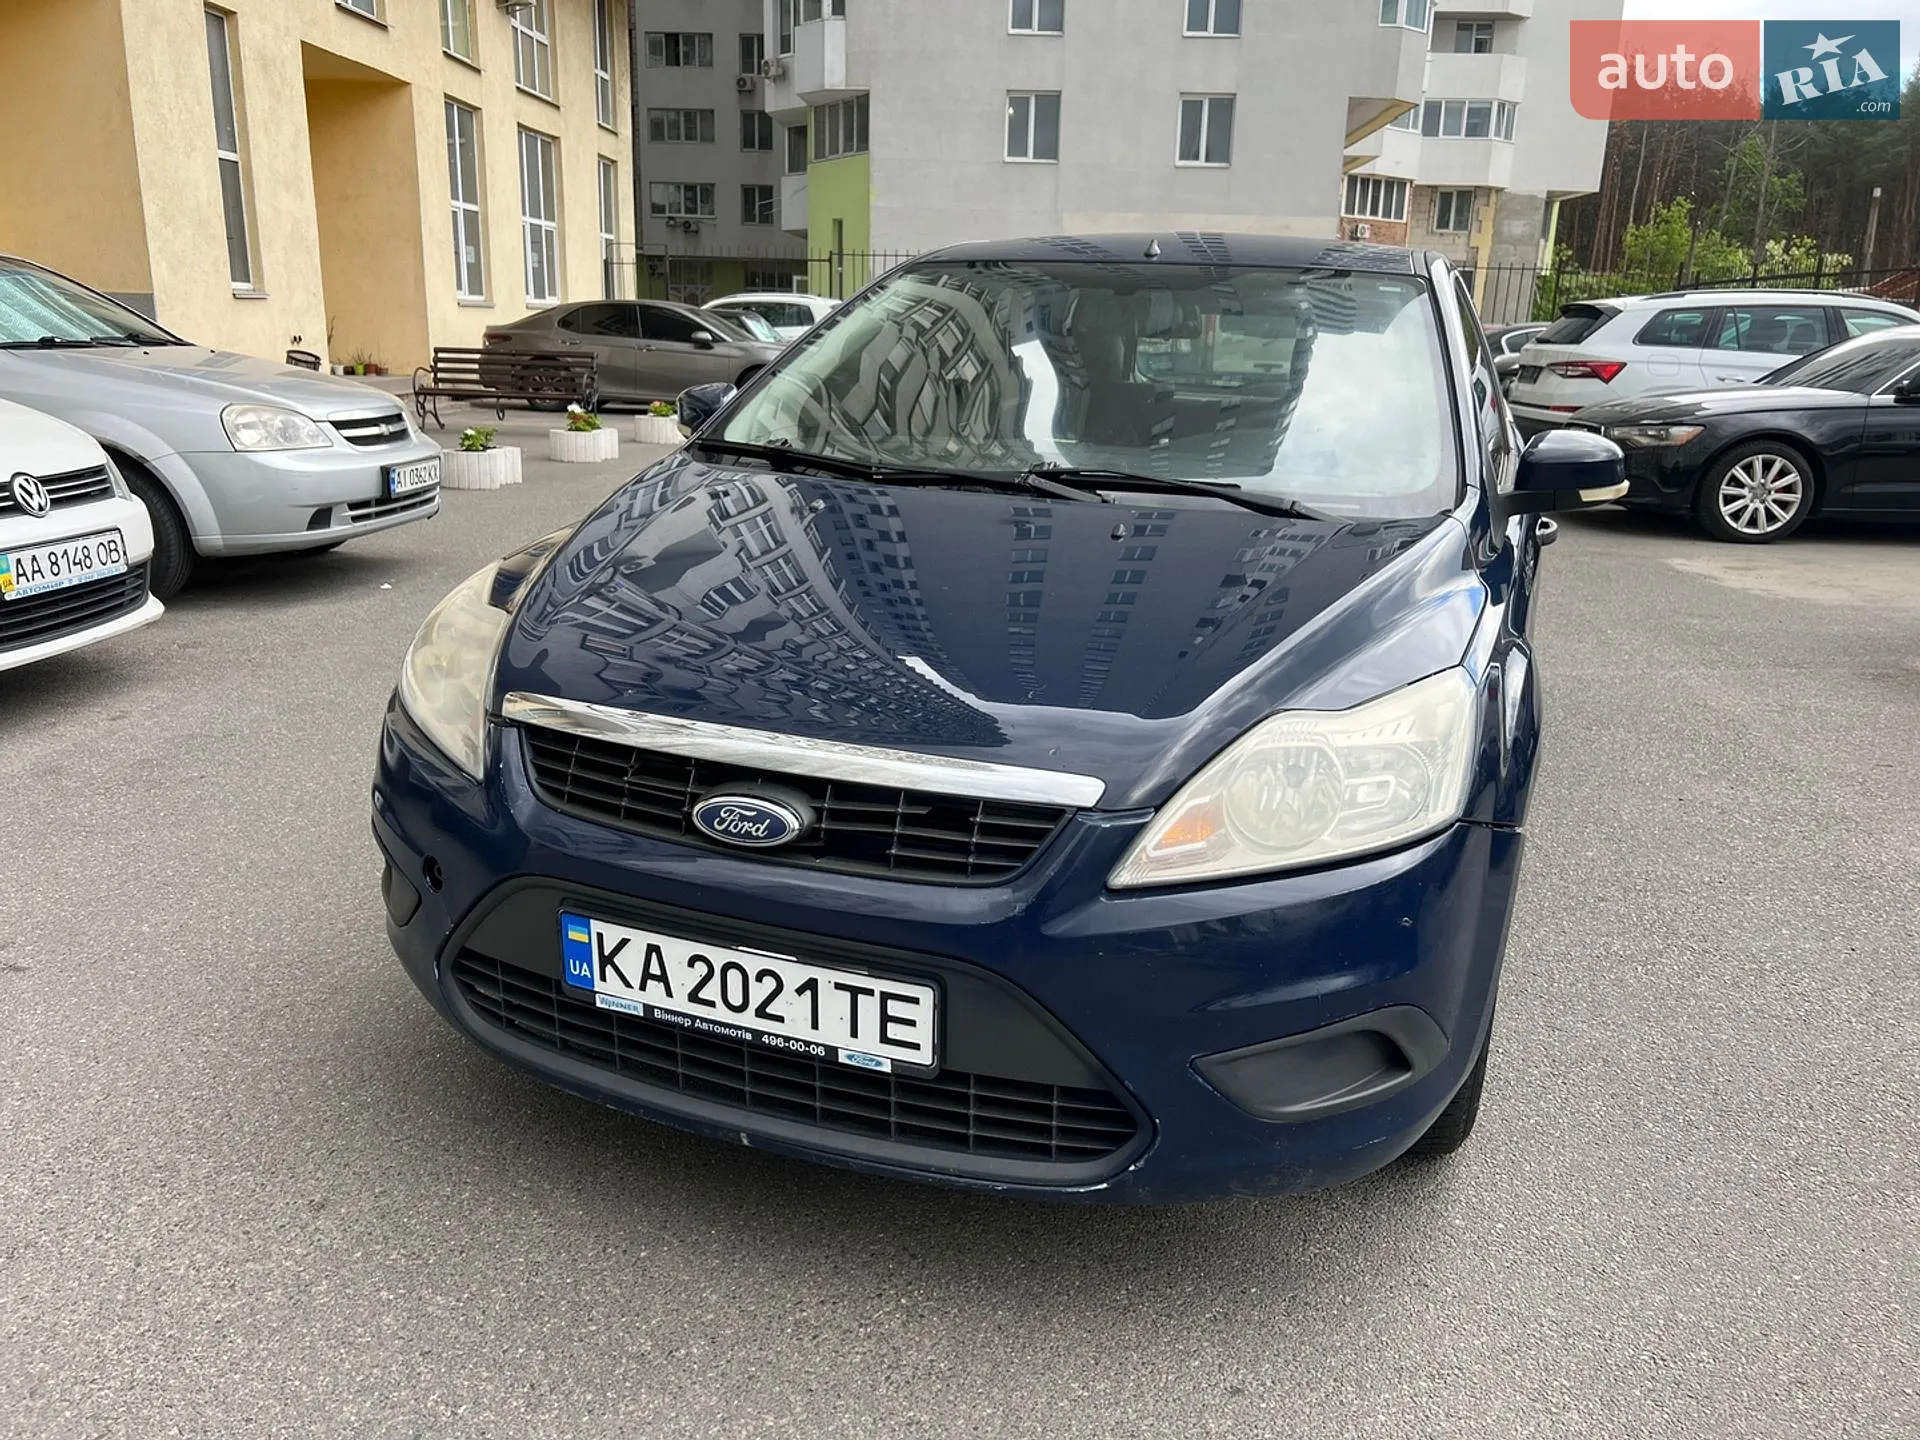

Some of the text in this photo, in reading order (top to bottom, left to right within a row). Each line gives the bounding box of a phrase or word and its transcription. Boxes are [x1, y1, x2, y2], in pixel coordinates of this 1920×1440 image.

[16, 554, 45, 585] AA
[47, 544, 94, 577] 8148
[97, 539, 120, 566] OB
[713, 805, 771, 837] Ford
[569, 957, 592, 979] UA
[595, 930, 923, 1052] KA 2021 TE
[653, 1008, 692, 1028] Віннер
[761, 1033, 826, 1057] 496-00-06
